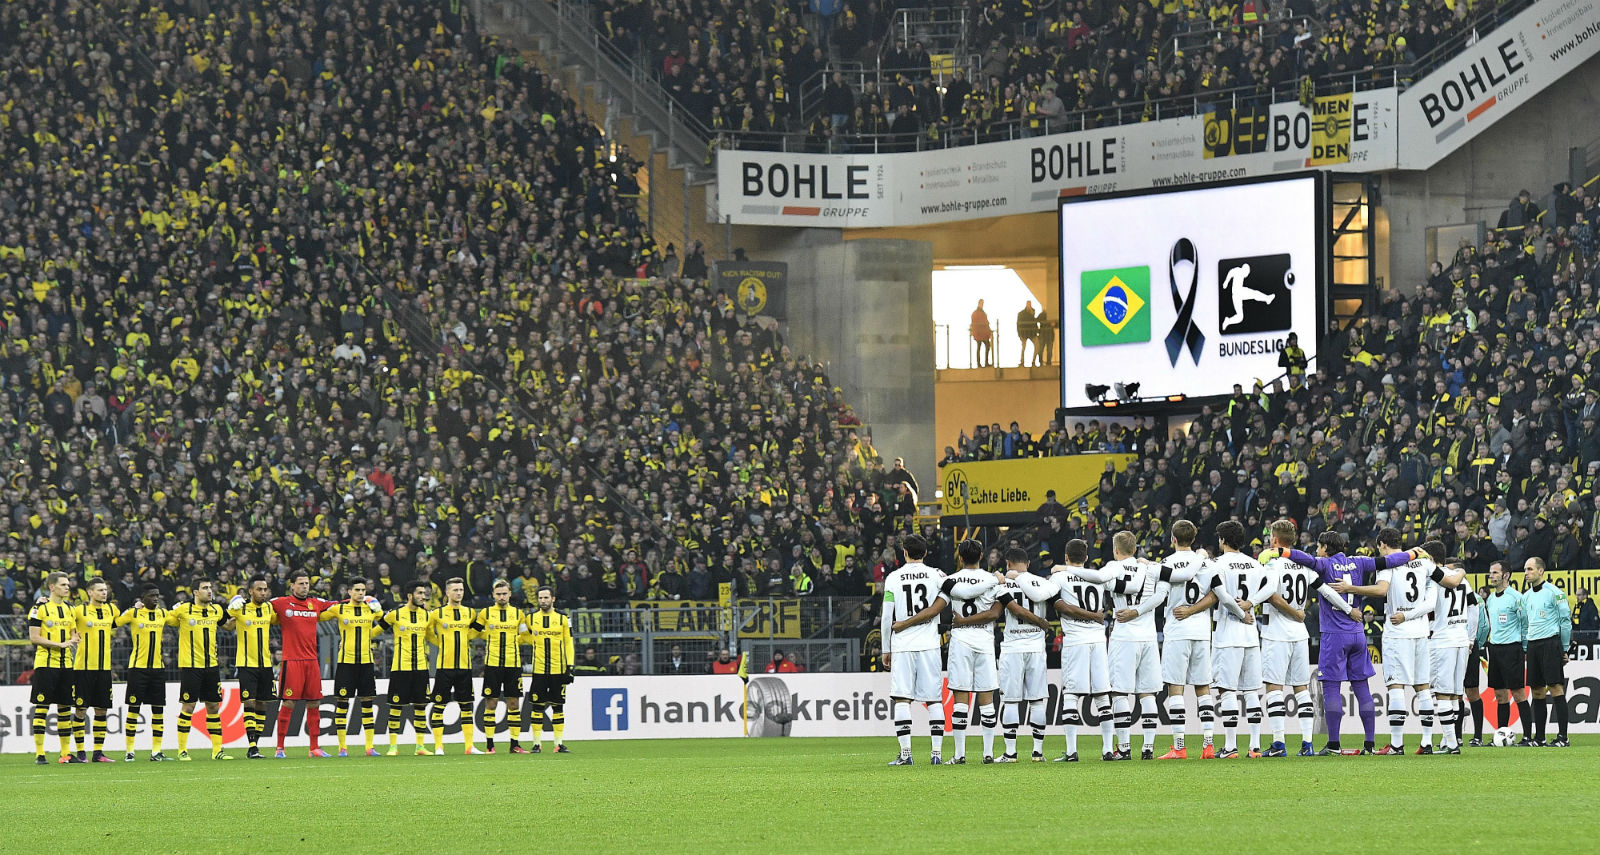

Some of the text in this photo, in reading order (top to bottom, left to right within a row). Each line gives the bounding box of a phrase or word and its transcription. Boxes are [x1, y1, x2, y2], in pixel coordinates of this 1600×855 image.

[1419, 38, 1525, 128] BOHLE
[1497, 73, 1530, 101] GRUPPE
[1313, 99, 1350, 116] MEN
[1274, 103, 1369, 152] BOE
[1030, 138, 1117, 184] BOHLE
[1313, 143, 1349, 159] DEN
[741, 161, 870, 199] BOHLE
[822, 207, 870, 218] GRUPPE
[920, 196, 1007, 214] www.bohle-gruppe.com
[1001, 487, 1031, 503] Liebe.
[900, 572, 929, 581] STINDL
[1238, 573, 1249, 602] 5
[1282, 573, 1307, 605] 30
[1405, 571, 1419, 603] 3
[902, 583, 929, 617] 13
[1073, 585, 1099, 613] 10
[1185, 577, 1200, 605] 6
[1444, 584, 1467, 618] 27
[962, 597, 978, 617] 8
